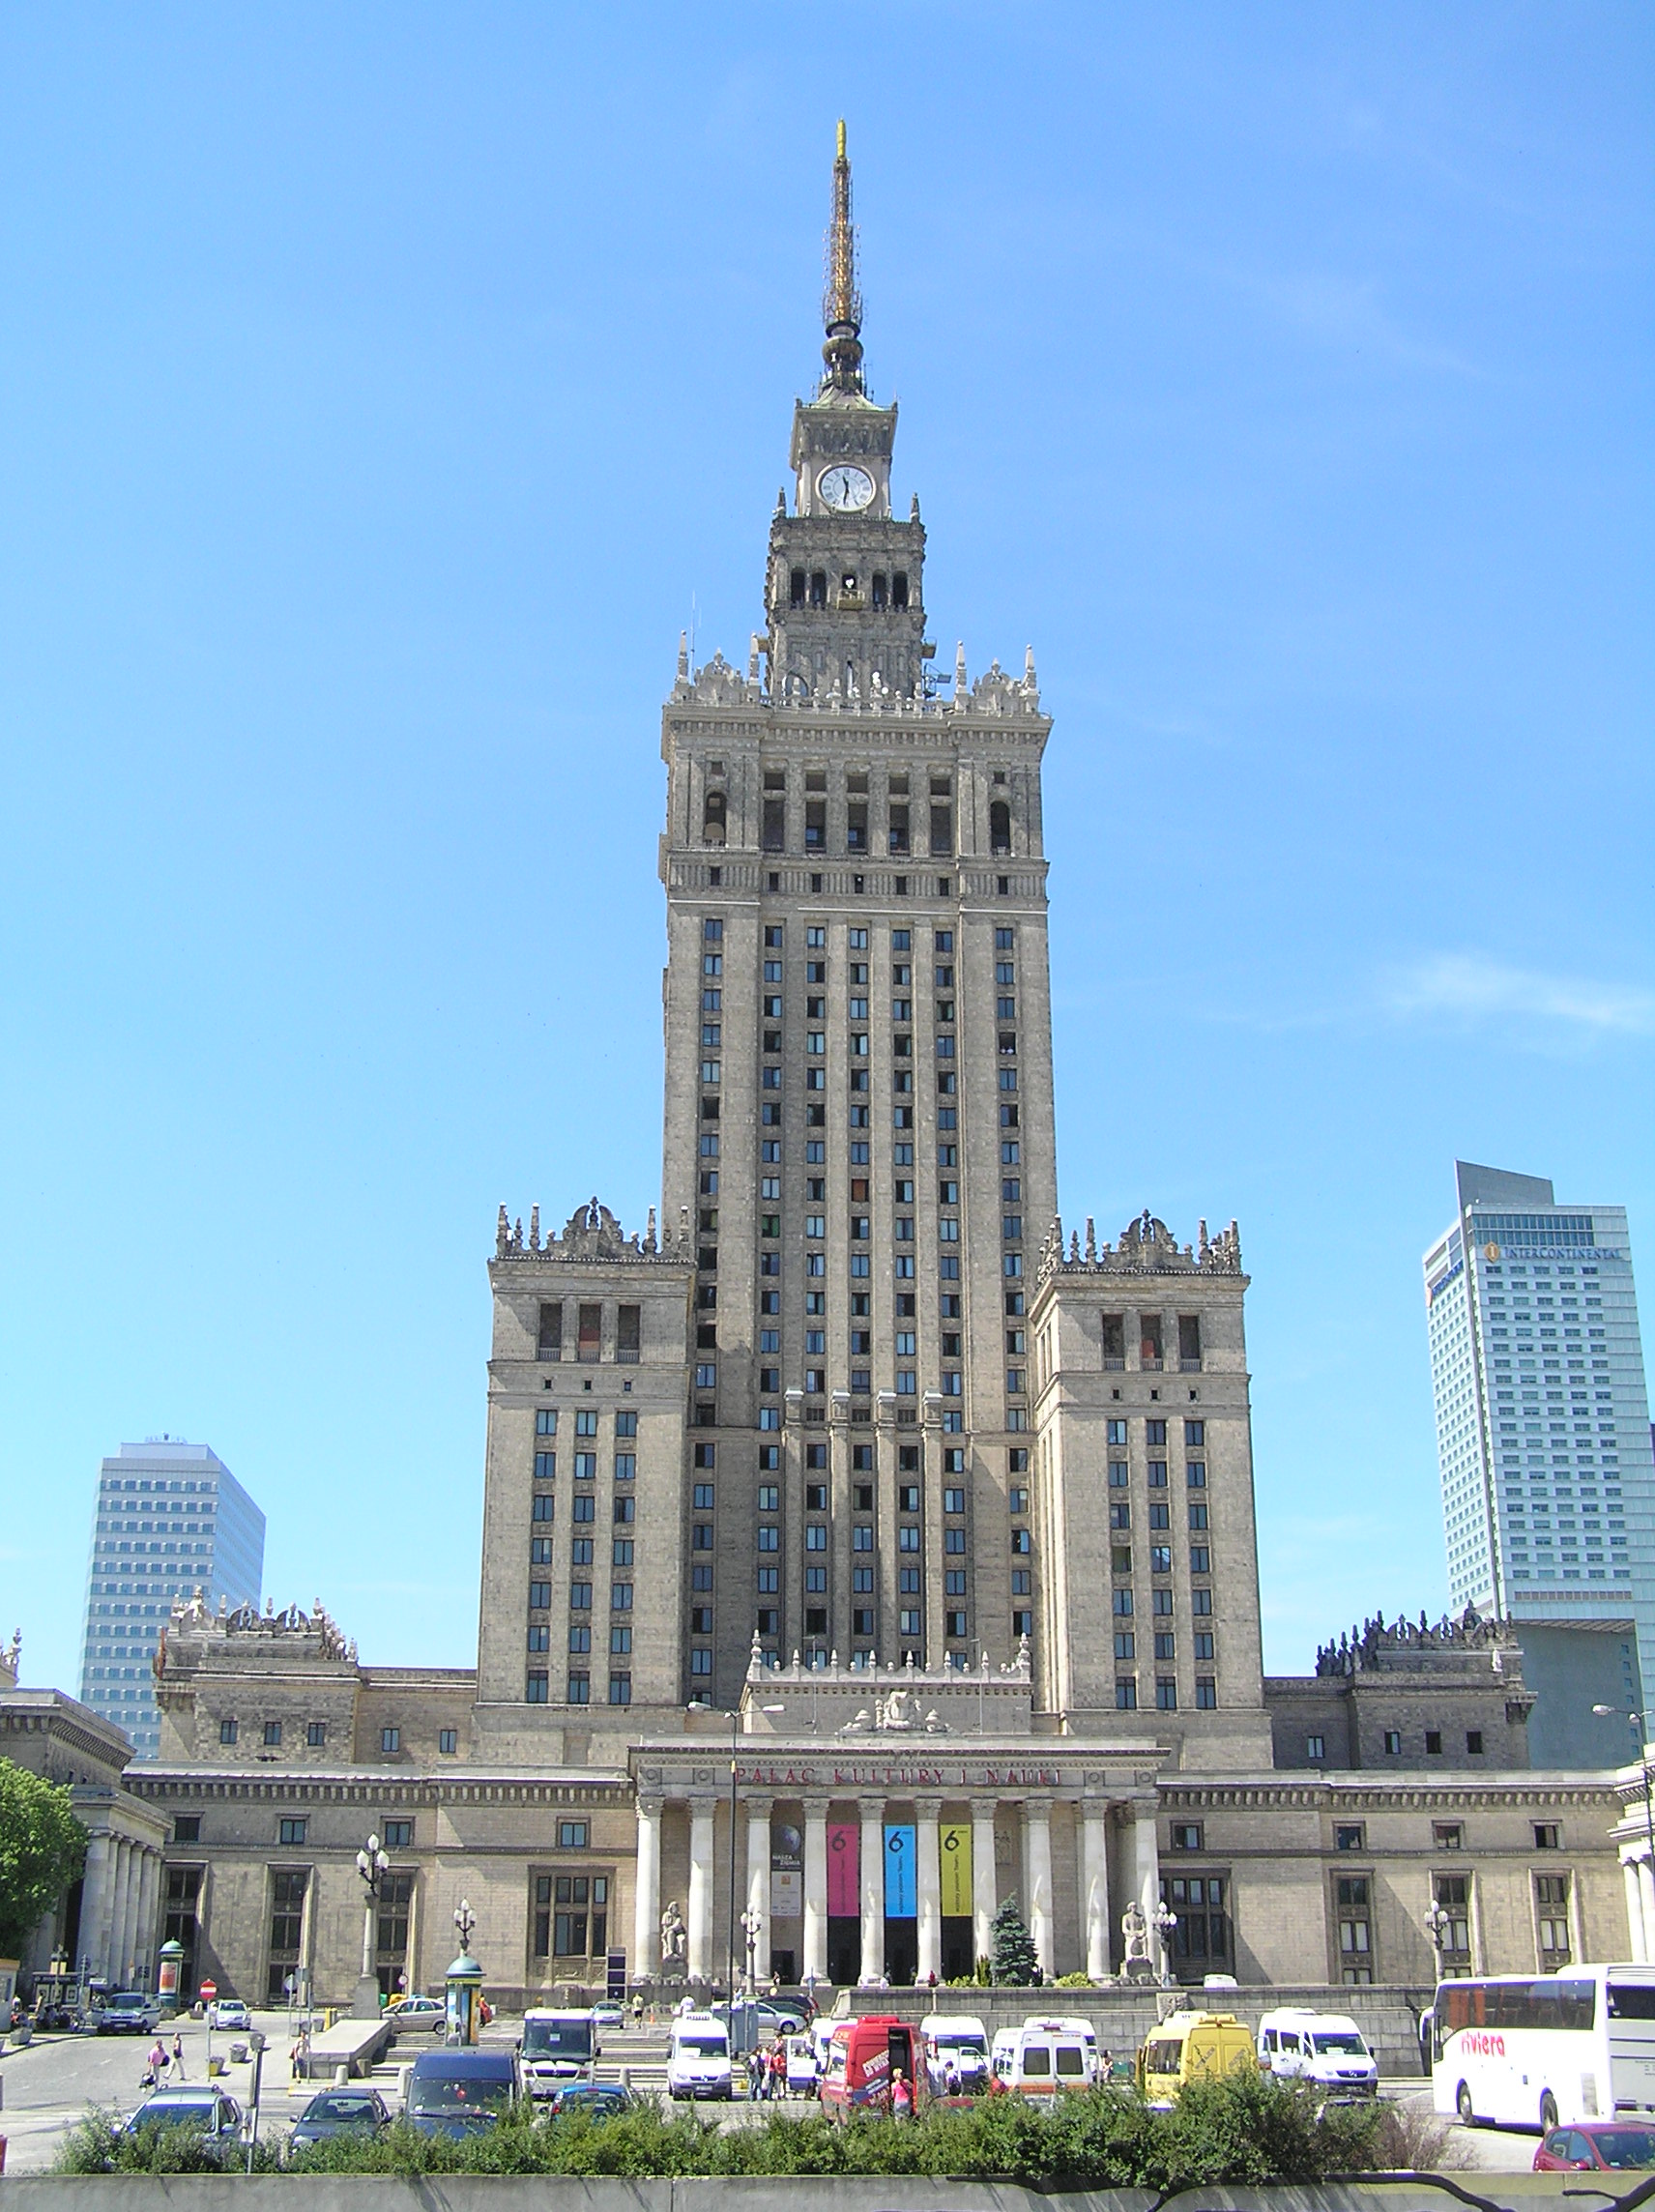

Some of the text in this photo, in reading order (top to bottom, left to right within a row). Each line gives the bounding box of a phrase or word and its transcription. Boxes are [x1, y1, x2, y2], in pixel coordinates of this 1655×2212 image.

[735, 1767, 1062, 1785] PAŁAC KULTURY I NAUKI
[832, 1830, 846, 1851] 6
[888, 1831, 904, 1853] 6
[944, 1830, 959, 1851] 6
[1461, 2030, 1505, 2057] riviera
